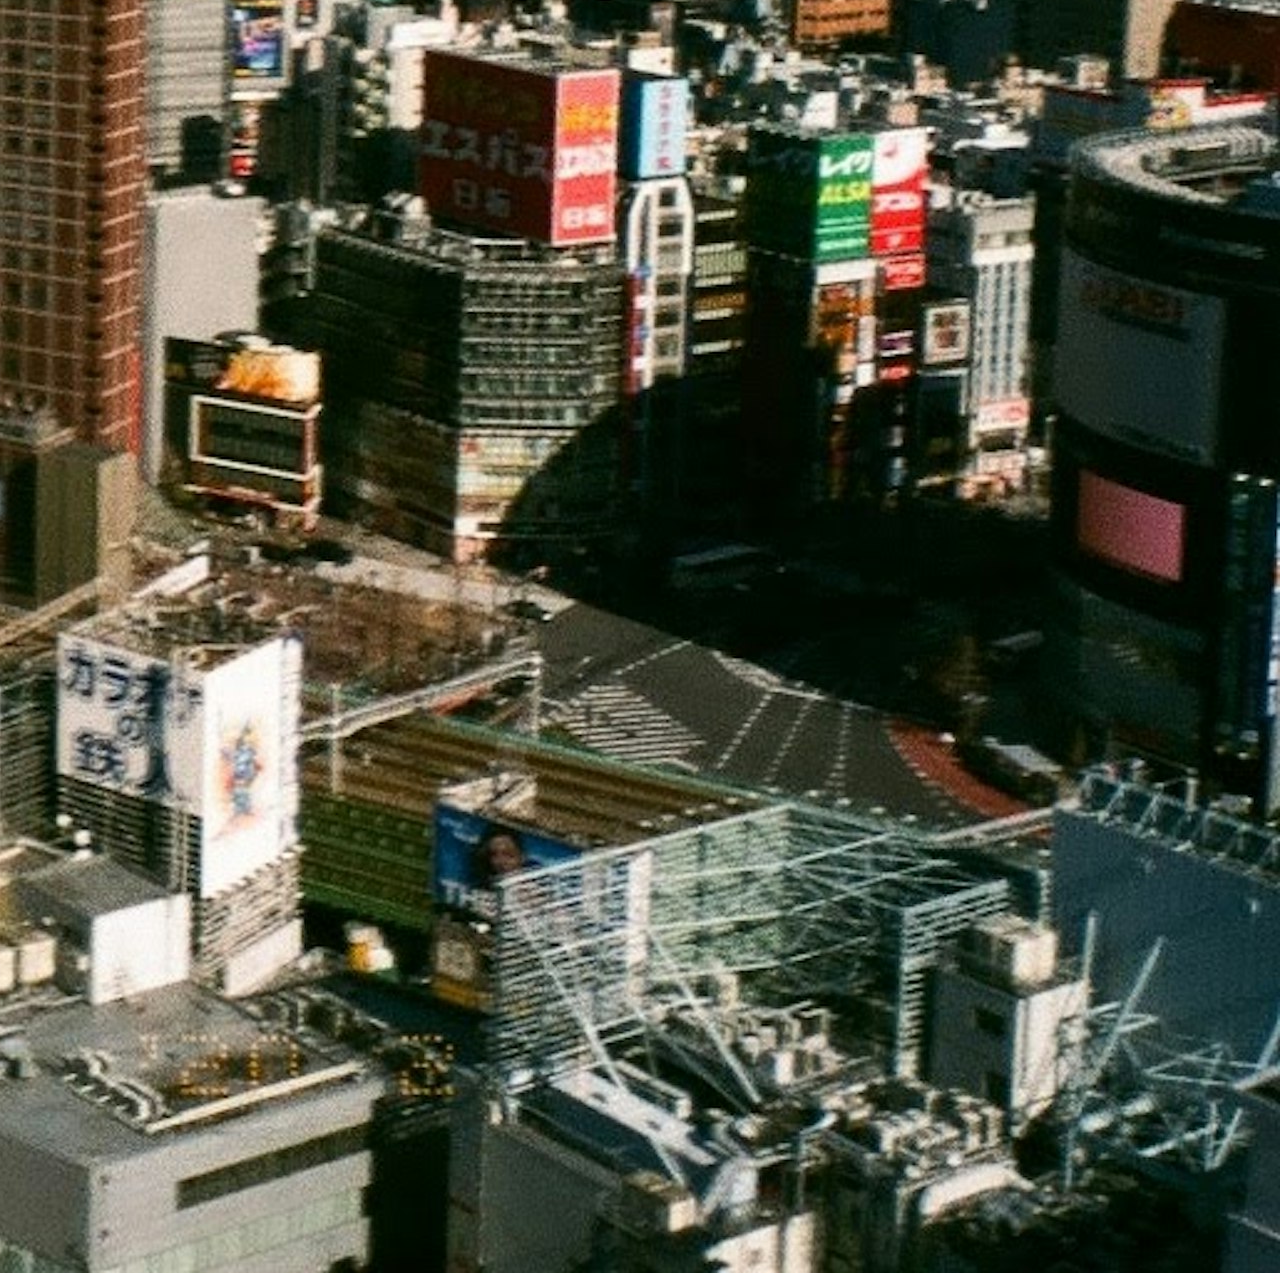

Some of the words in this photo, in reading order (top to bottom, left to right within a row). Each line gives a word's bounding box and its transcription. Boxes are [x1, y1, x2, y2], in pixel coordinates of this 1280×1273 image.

[418, 119, 551, 180] エスパス
[818, 150, 872, 179] レイク
